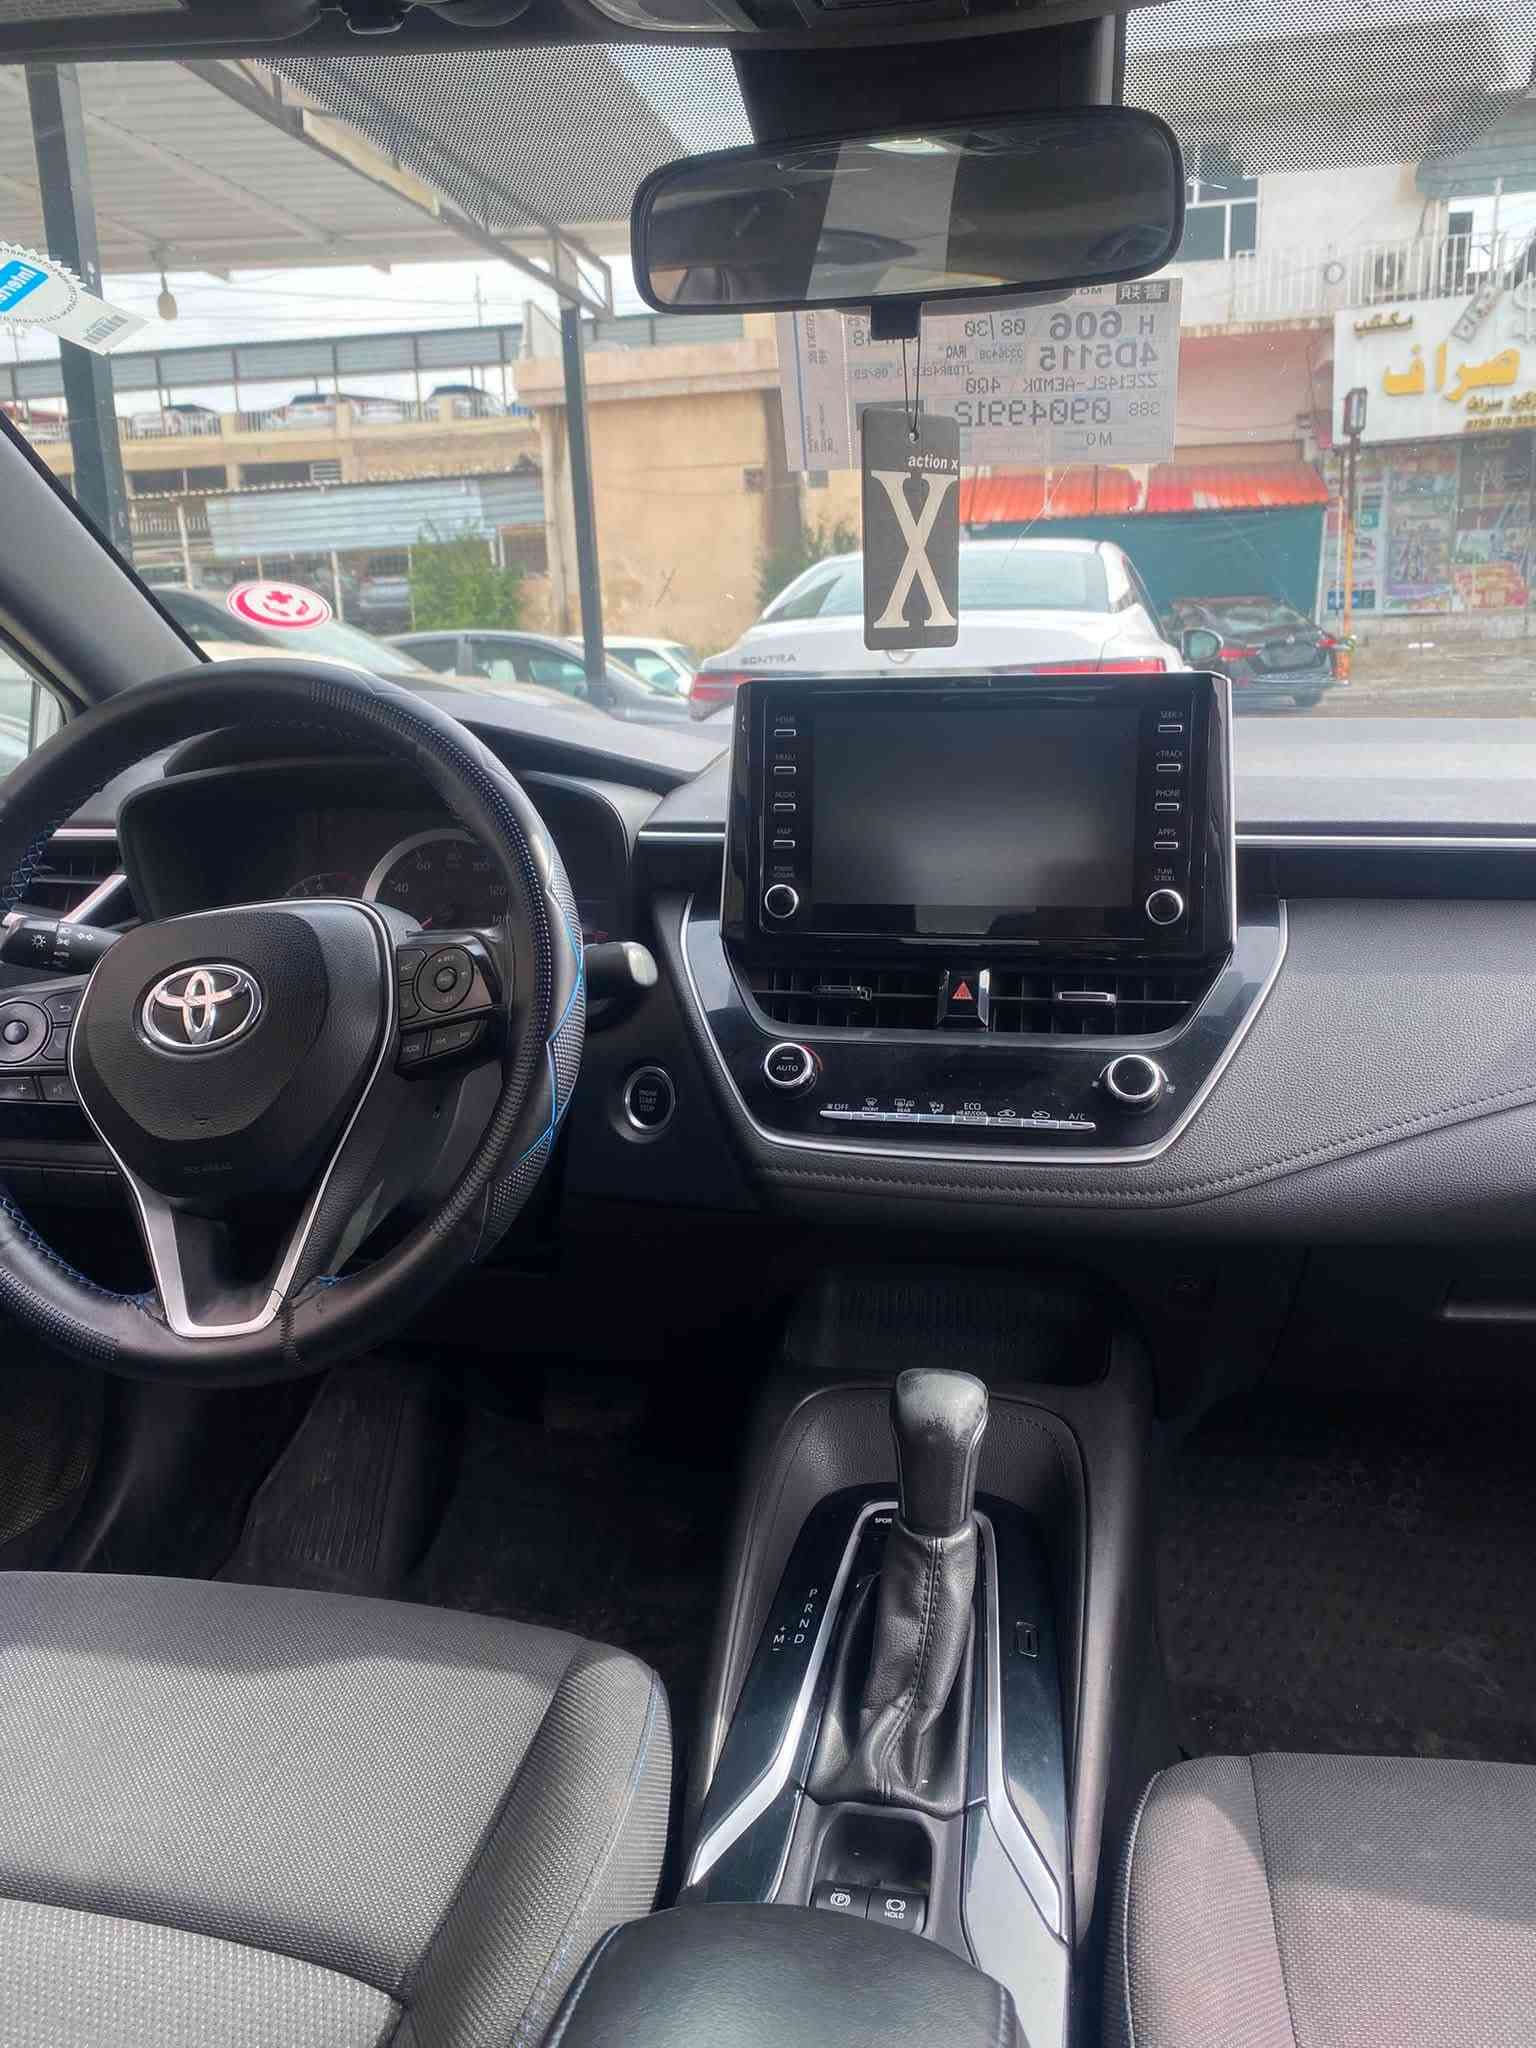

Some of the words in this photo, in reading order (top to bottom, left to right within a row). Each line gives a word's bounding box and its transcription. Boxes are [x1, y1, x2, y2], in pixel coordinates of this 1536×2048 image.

[908, 455, 948, 470] action
[950, 459, 960, 471] x
[871, 470, 958, 629] X
[964, 1103, 982, 1111] ECO
[1068, 1112, 1086, 1120] A/C
[809, 1588, 818, 1598] P
[804, 1603, 814, 1613] R
[799, 1618, 810, 1629] N
[773, 1634, 785, 1644] M
[794, 1633, 805, 1644] D
[884, 1911, 905, 1920] HOLD
